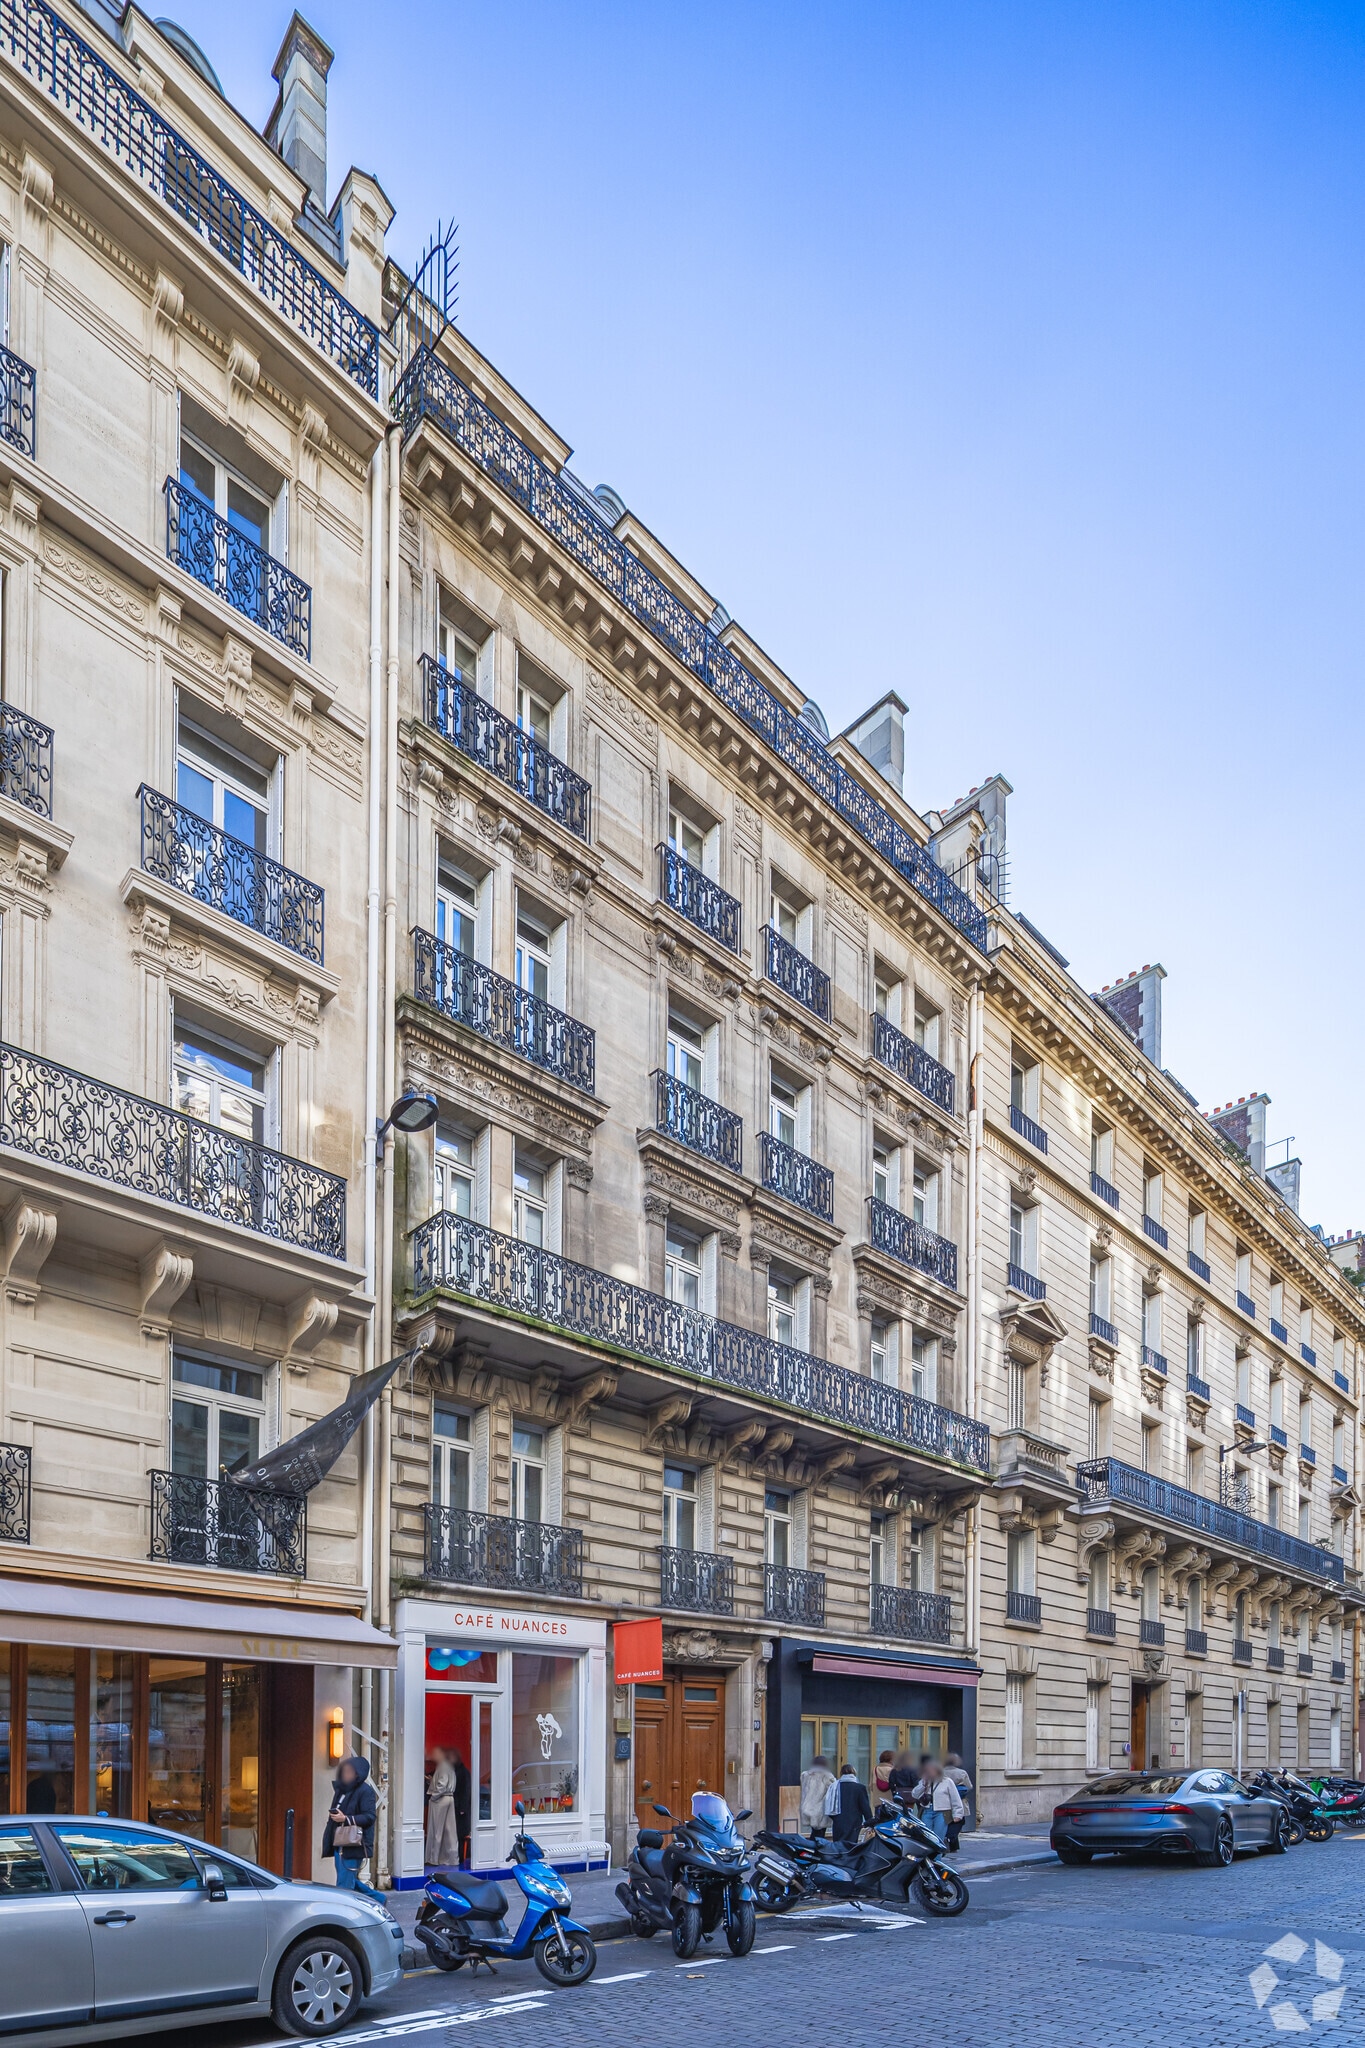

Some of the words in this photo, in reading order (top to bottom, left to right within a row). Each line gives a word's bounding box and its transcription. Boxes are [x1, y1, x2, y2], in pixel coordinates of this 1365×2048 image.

[291, 1457, 302, 1469] DE
[454, 1613, 493, 1628] CAFÉ
[501, 1617, 568, 1635] NUANCES
[632, 1669, 660, 1678] NUANCES
